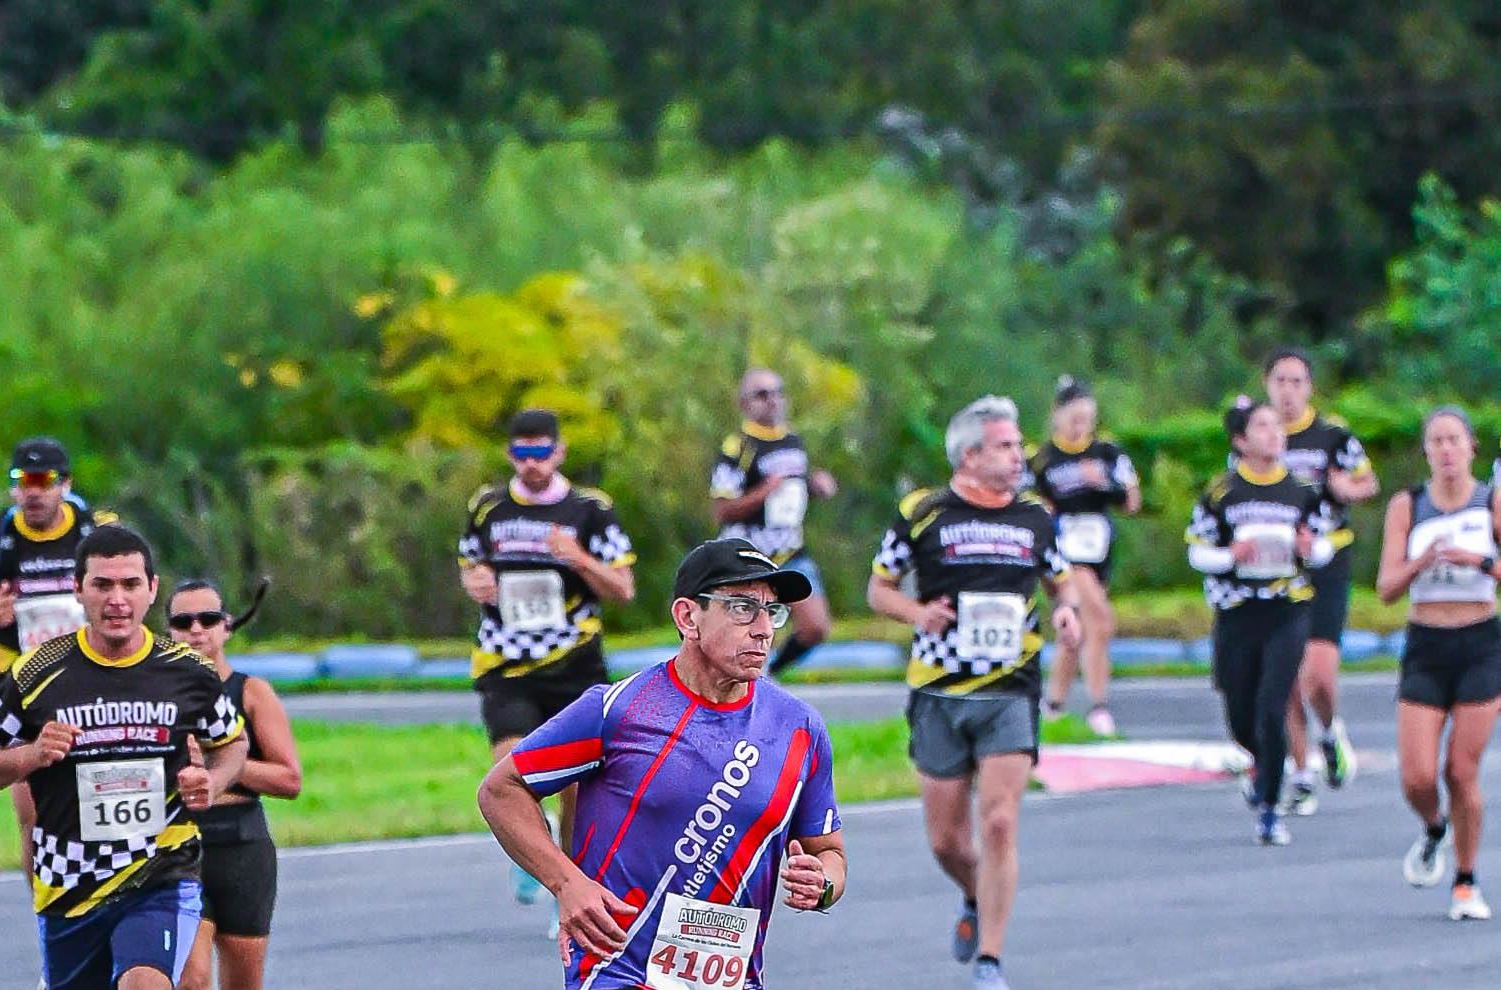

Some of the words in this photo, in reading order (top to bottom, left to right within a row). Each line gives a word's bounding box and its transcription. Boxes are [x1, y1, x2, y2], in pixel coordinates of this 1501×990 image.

[971, 628, 1013, 648] 102
[56, 697, 179, 728] AUTÓDROMO
[127, 727, 158, 742] RACE
[94, 799, 152, 826] 166
[674, 740, 761, 864] cronos
[678, 908, 747, 933] AUTÓDROMO
[651, 945, 744, 987] 4109
